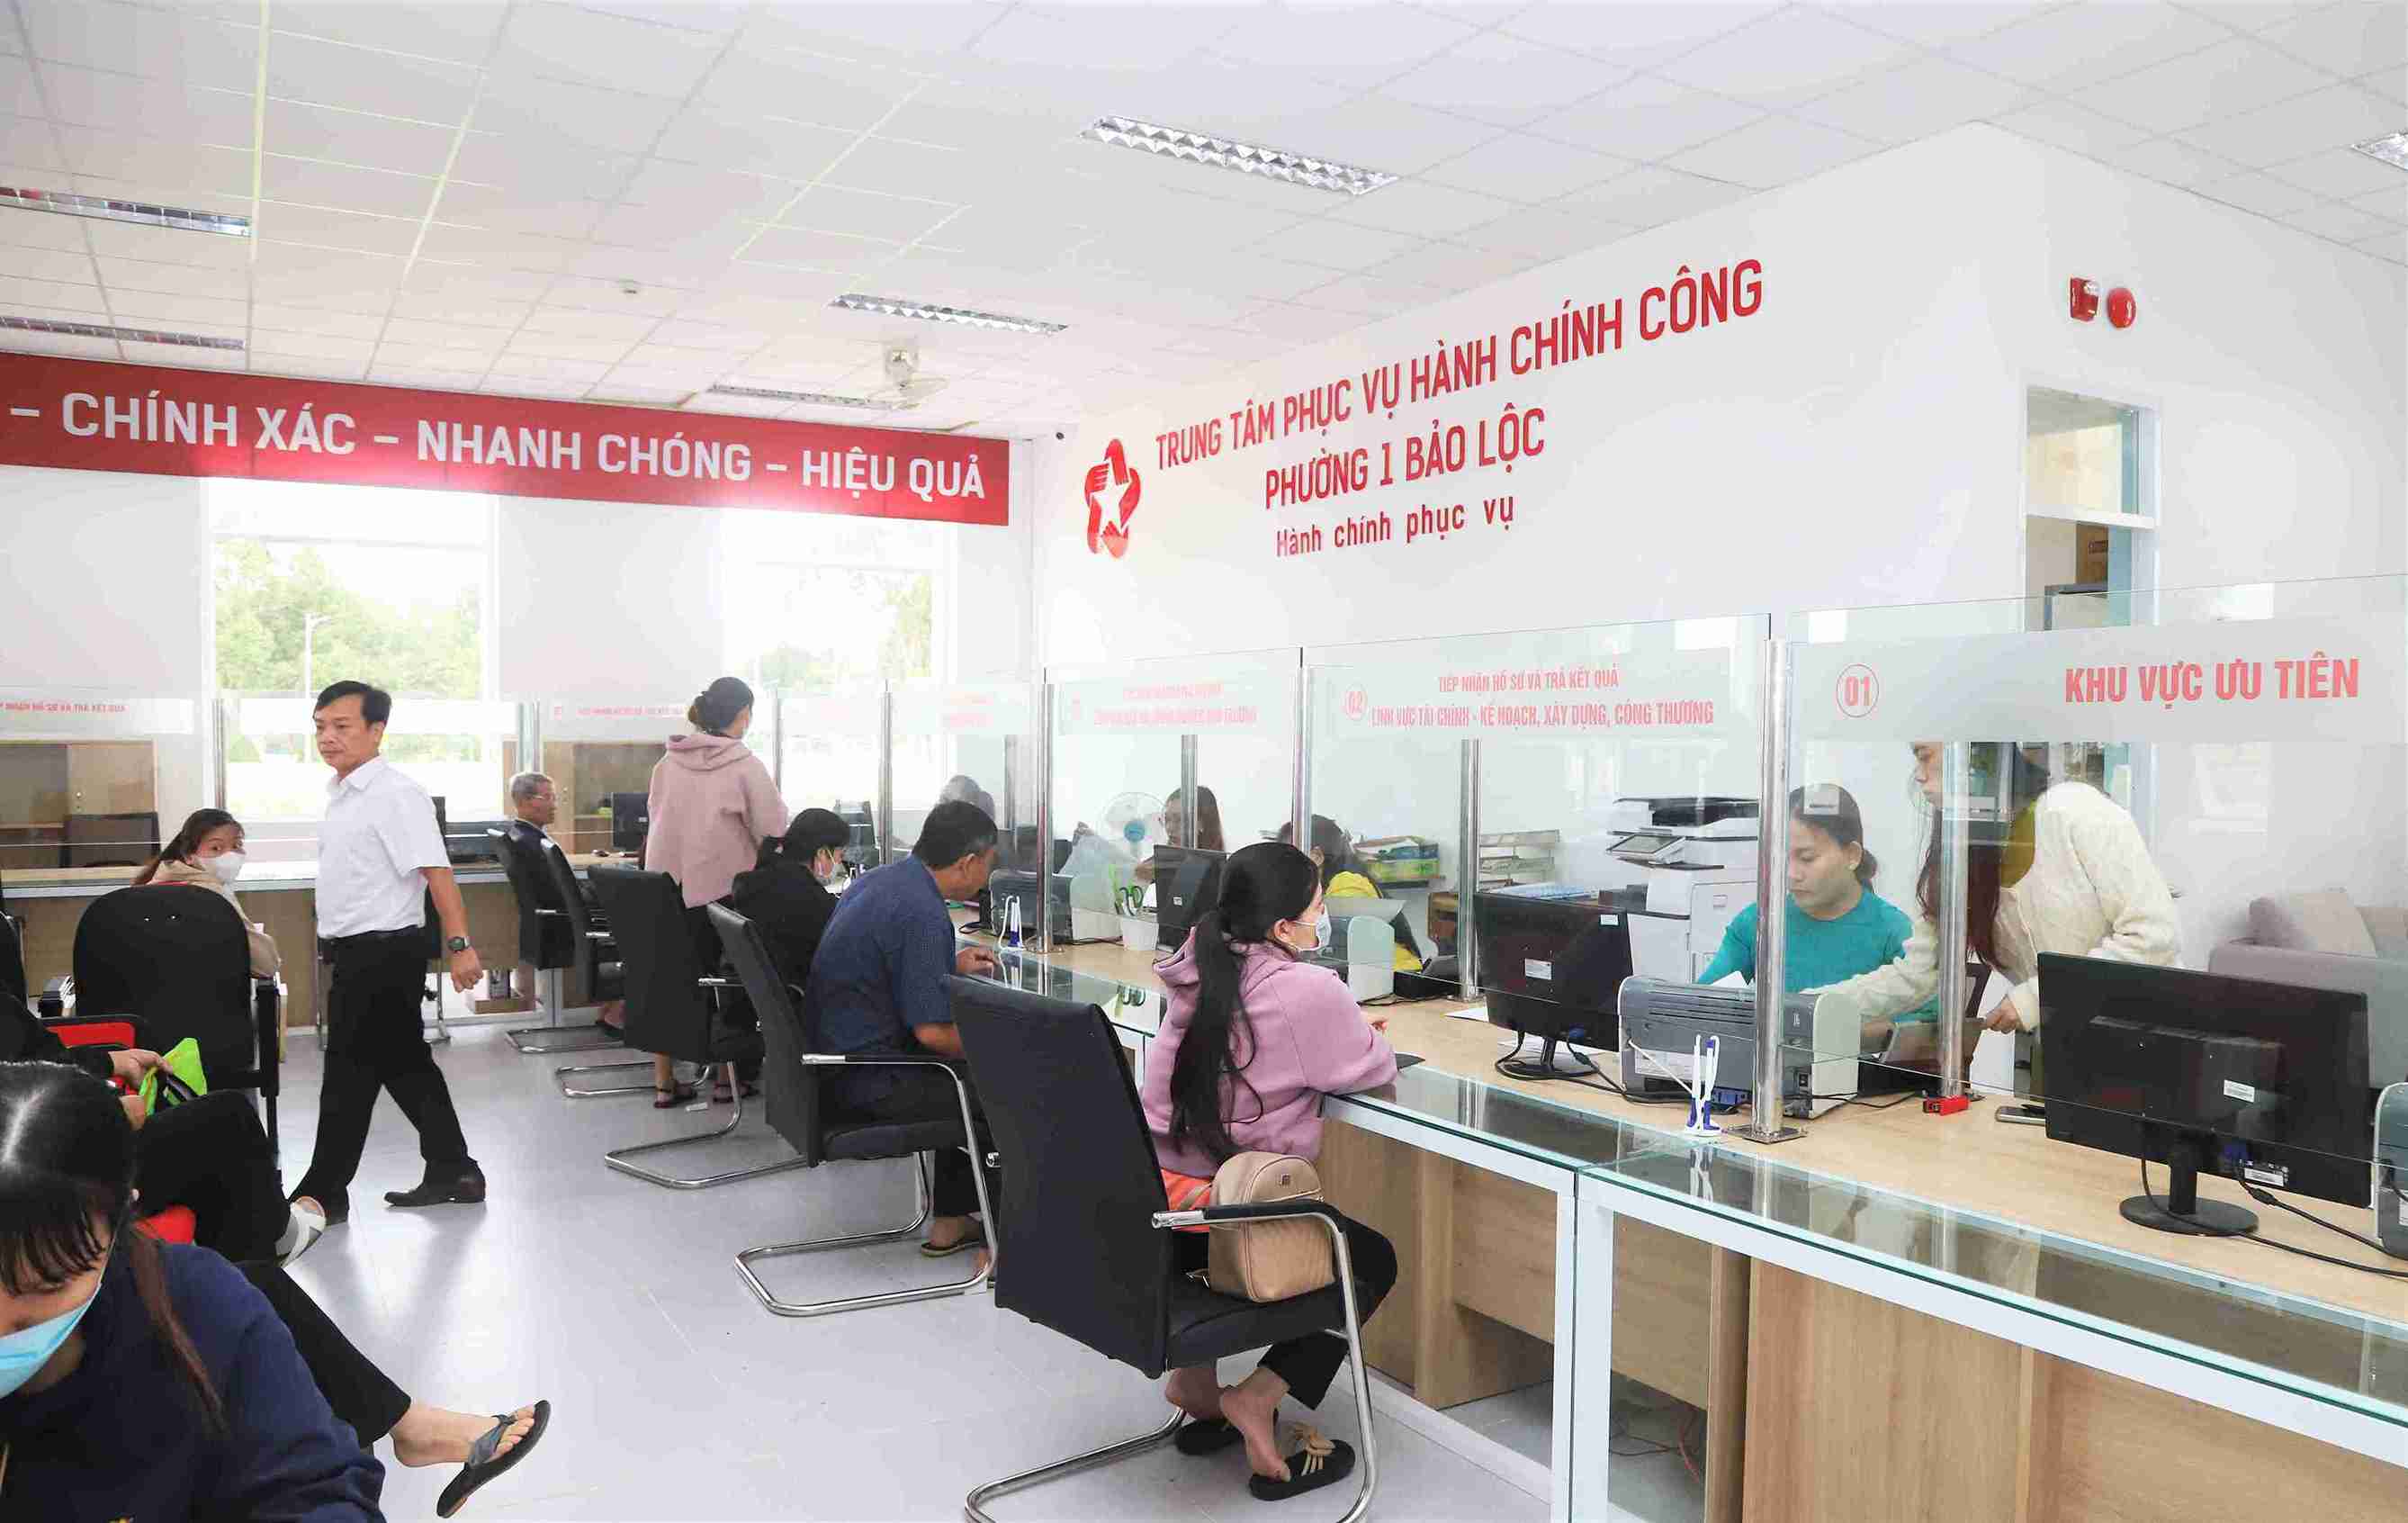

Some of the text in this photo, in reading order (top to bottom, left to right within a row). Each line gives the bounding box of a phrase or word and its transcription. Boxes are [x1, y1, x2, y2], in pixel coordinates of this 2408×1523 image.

[1155, 259, 1763, 470] TRUNG TÂM PHỤC VỤ HÀNH CHÍNH CÔNG
[62, 390, 238, 447] CHÍNH
[255, 402, 355, 454] XÁC
[417, 419, 581, 471] NHANH
[598, 431, 751, 482] CHÓNG
[802, 446, 894, 499] HIỆU
[908, 454, 985, 502] QUẢ
[1265, 402, 1545, 509] PHƯỜNG 1 BẢO LỘC
[1276, 496, 1514, 557] Hành chính phục vụ
[1845, 675, 1871, 707] 01
[2065, 650, 2359, 709] KHU VỰC ƯU TIÊN
